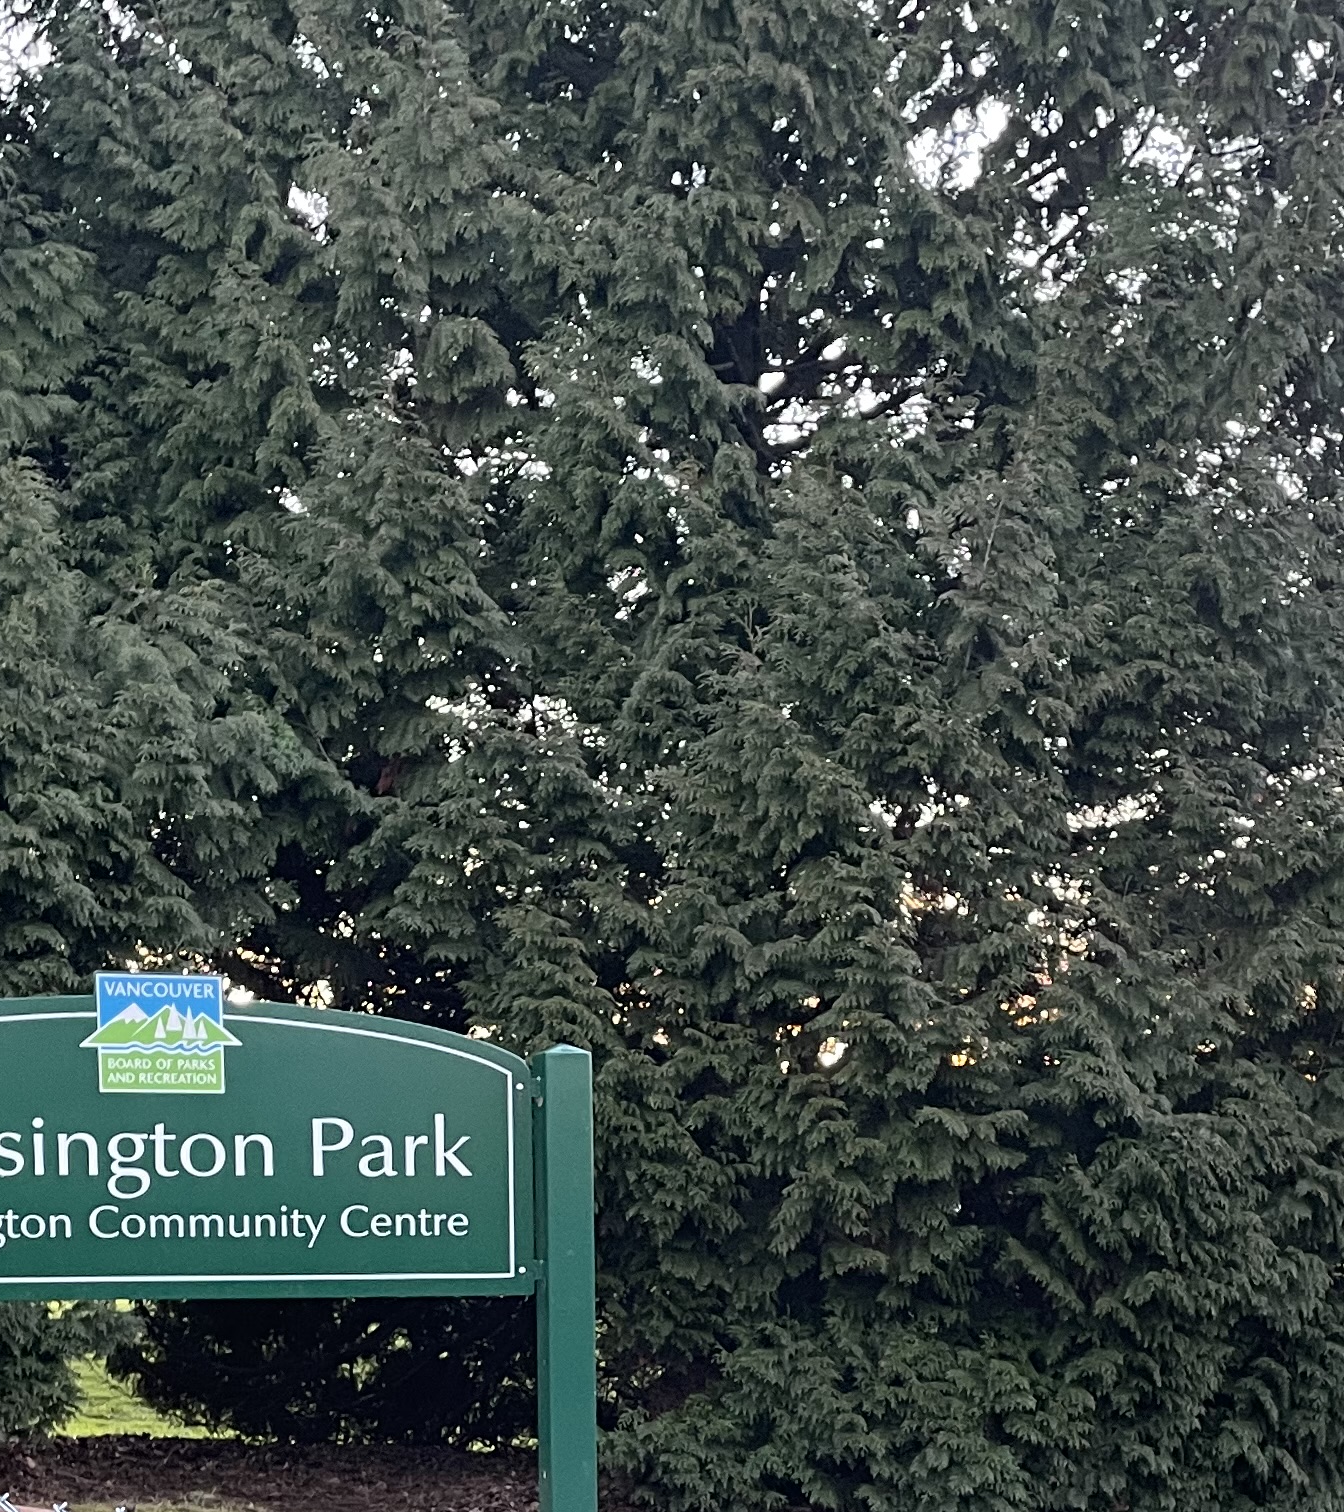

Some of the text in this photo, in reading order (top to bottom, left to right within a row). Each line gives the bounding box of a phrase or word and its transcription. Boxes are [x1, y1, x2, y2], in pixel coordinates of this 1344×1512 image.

[104, 981, 215, 999] VANCOUVER
[107, 1058, 216, 1071] BOARD OF PARKS
[107, 1072, 217, 1085] AND RECREATION
[311, 1112, 473, 1179] Park
[88, 1204, 326, 1249] Community
[340, 1204, 470, 1239] Centre
